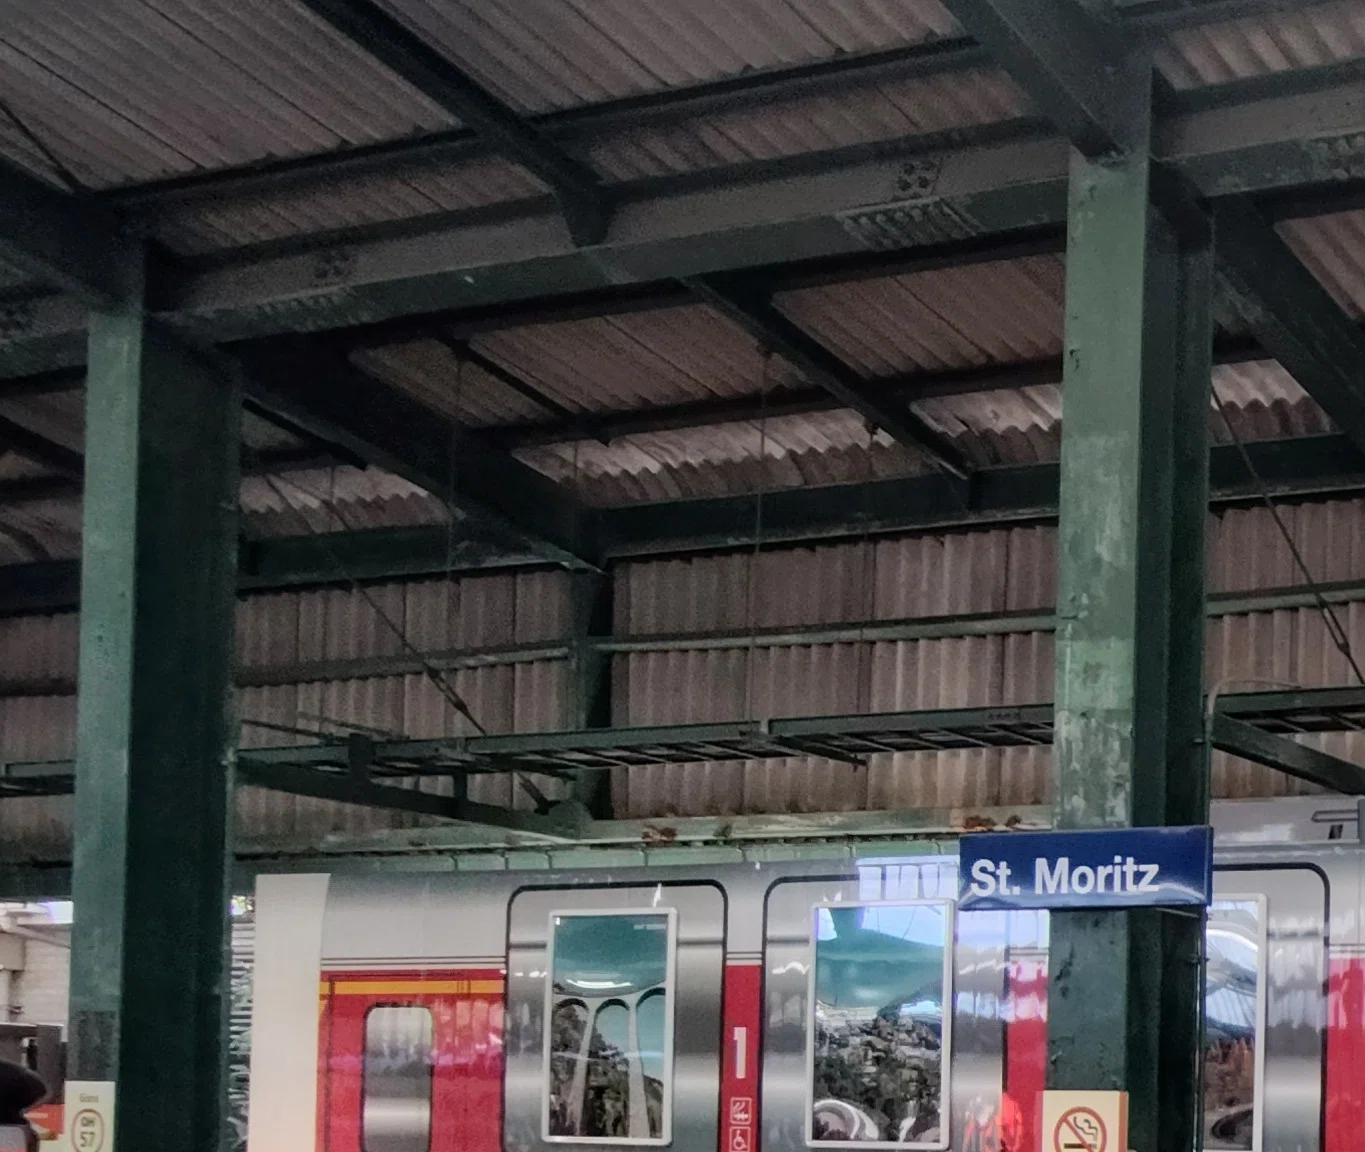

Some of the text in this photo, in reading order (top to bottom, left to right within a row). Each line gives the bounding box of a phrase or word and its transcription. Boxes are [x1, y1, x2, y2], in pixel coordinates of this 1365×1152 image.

[970, 855, 1160, 897] St. Moritz
[733, 1026, 747, 1079] 1
[79, 1131, 96, 1149] 57
